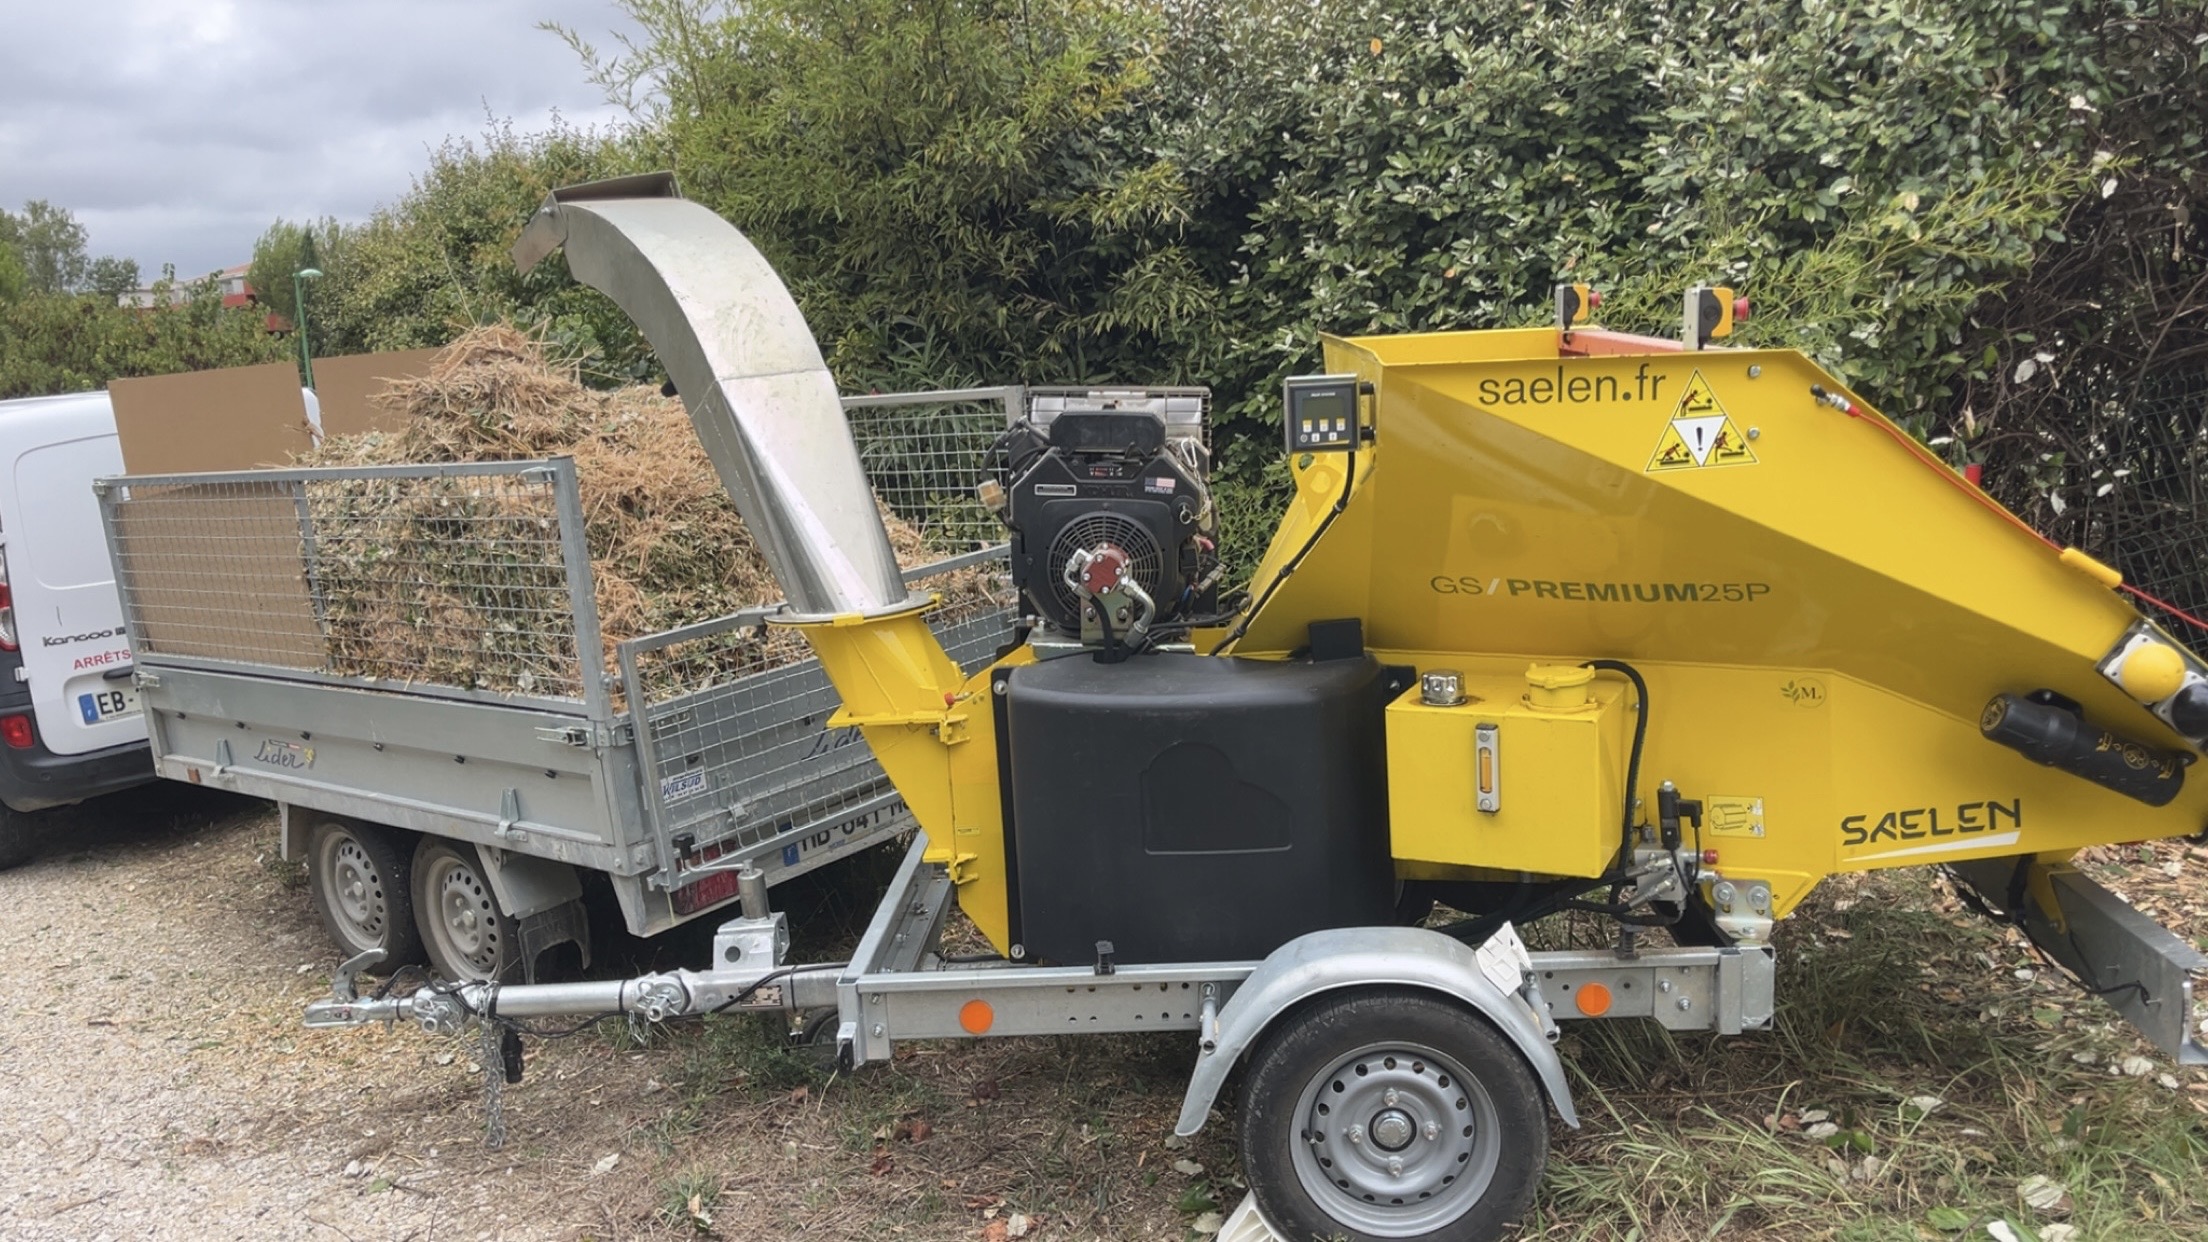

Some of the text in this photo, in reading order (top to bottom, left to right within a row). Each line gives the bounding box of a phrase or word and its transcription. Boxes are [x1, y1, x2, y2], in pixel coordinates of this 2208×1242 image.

[1478, 362, 1666, 406] saelen.fr
[42, 630, 113, 647] Kangoo
[73, 649, 132, 670] ARRÊTS
[1841, 798, 2021, 846] SAELEN
